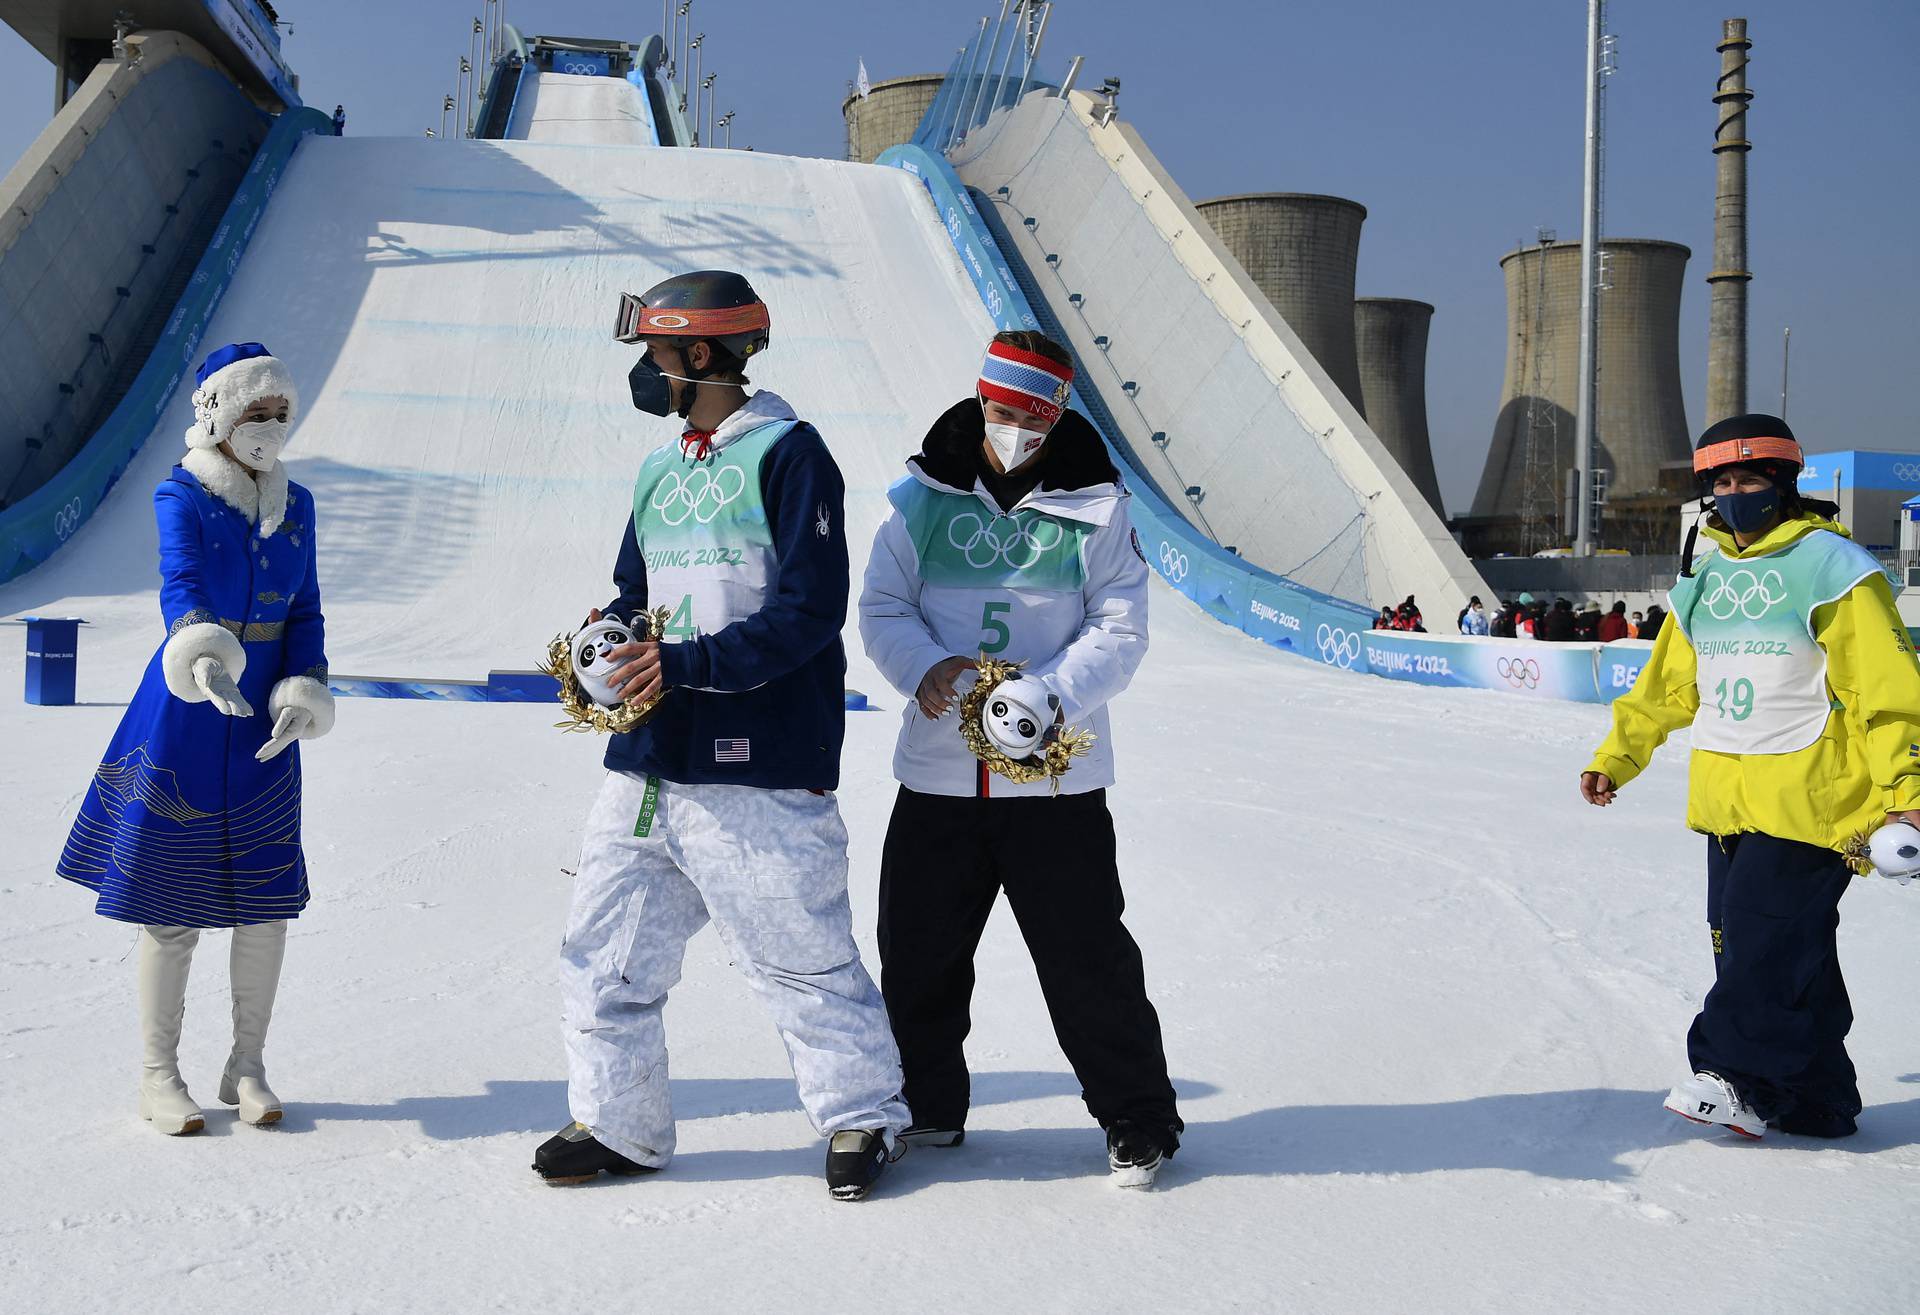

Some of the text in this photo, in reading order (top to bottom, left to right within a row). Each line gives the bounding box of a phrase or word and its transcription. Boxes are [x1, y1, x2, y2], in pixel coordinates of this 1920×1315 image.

[645, 547, 749, 574] EIJING 2022
[664, 594, 696, 641] 4
[977, 602, 1011, 653] 5
[1250, 599, 1301, 631] BEIJING 2022
[1366, 646, 1453, 676] BEIJING 2022
[1743, 640, 1794, 657] 2022
[1715, 677, 1755, 722] 19
[1698, 1101, 1716, 1114] FT
